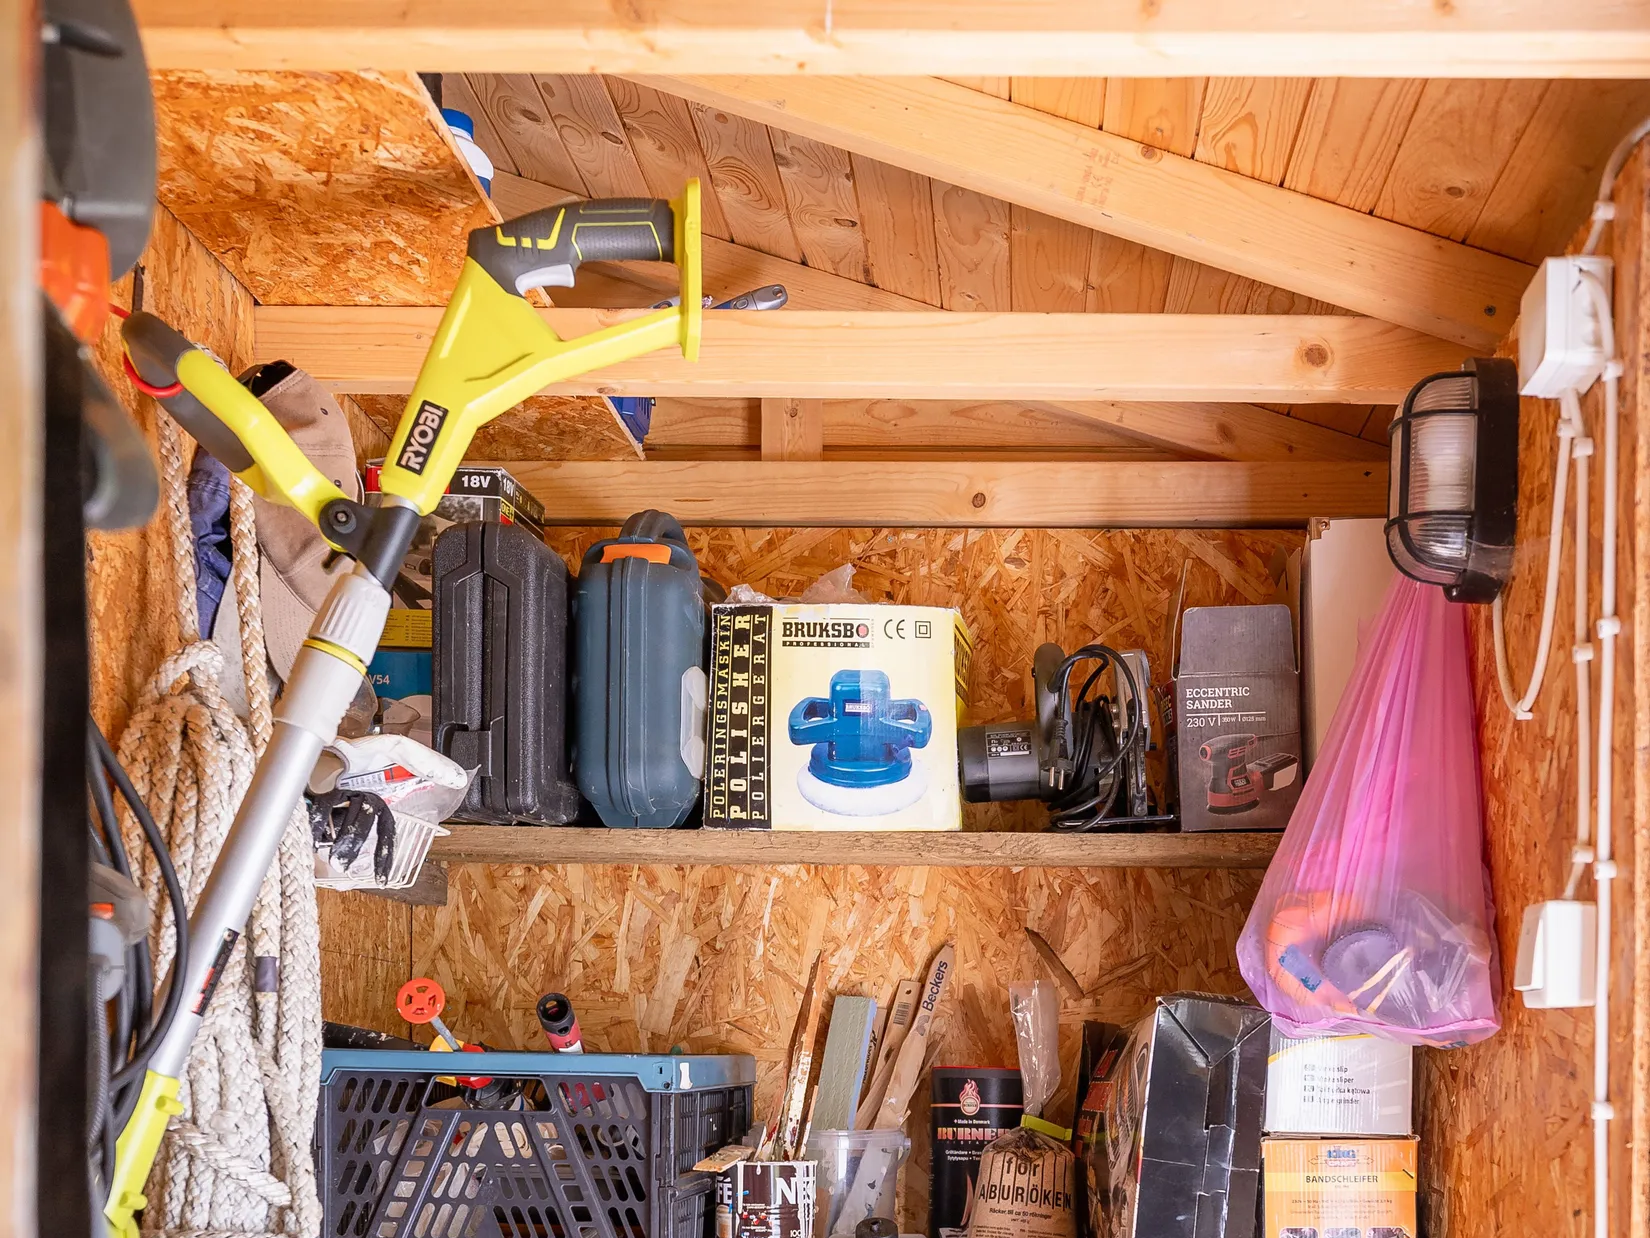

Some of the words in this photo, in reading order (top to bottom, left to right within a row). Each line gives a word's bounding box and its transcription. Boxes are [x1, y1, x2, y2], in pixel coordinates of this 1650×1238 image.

[400, 404, 444, 471] RYOBI
[461, 475, 491, 488] 18V
[502, 477, 515, 498] 18V
[782, 621, 869, 638] BRUKSBO
[1186, 686, 1250, 698] ECCENTRIC
[1186, 699, 1233, 710] SANDER
[713, 614, 732, 819] POLERINGSMASKIN
[730, 614, 751, 820] POLISHER
[752, 614, 767, 820] POLIERGERAT
[1186, 717, 1206, 728] 230
[1208, 717, 1216, 727] V
[922, 960, 948, 1012] Beckers
[1305, 1175, 1379, 1183] BANDSCHLEIFER
[979, 1183, 1073, 1209] ABURÖKEN
